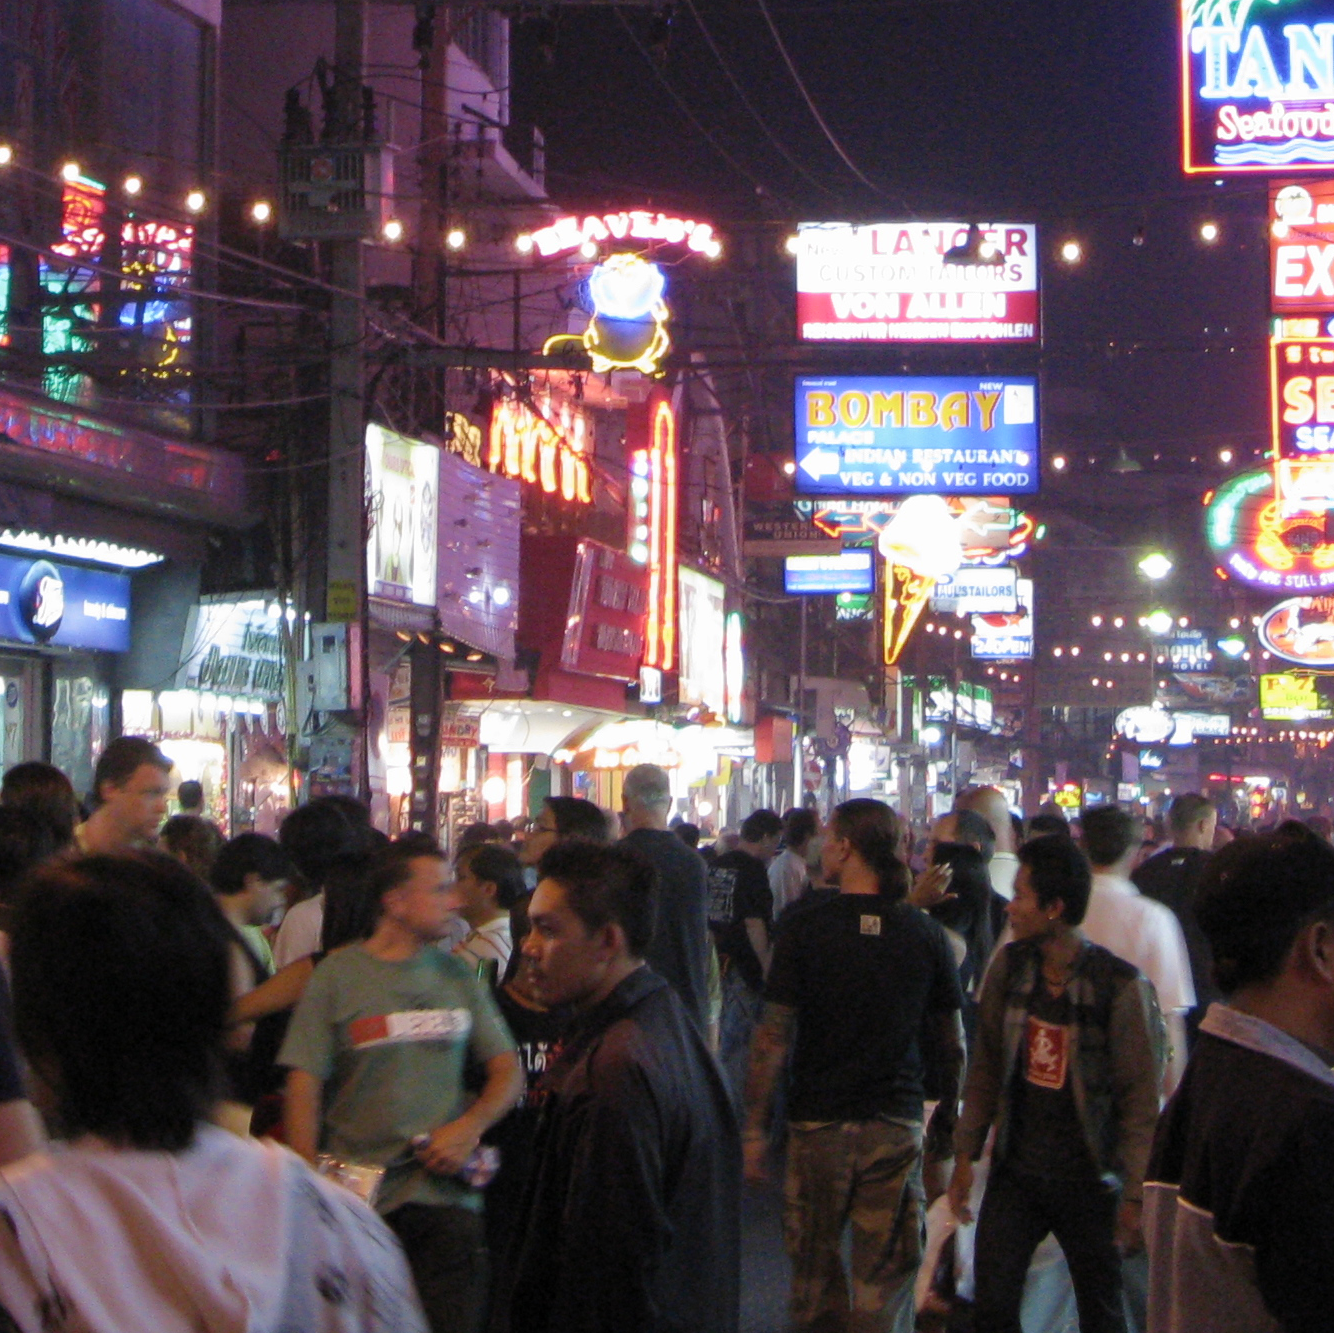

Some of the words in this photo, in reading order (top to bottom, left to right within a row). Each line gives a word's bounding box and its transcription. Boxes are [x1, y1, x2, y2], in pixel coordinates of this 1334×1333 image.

[819, 264, 914, 282] CUSTOM
[928, 263, 1023, 282] TAILORS
[830, 293, 900, 318] VON
[905, 293, 1006, 318] ALLEN
[806, 389, 1003, 432] BOMBAY
[845, 448, 906, 464] INDIAN
[912, 449, 1027, 464] RESTAURANT
[840, 472, 875, 487] VEG
[879, 472, 893, 487] &
[898, 472, 936, 487] NON
[943, 472, 977, 487] VEG
[983, 472, 1029, 487] FOOD
